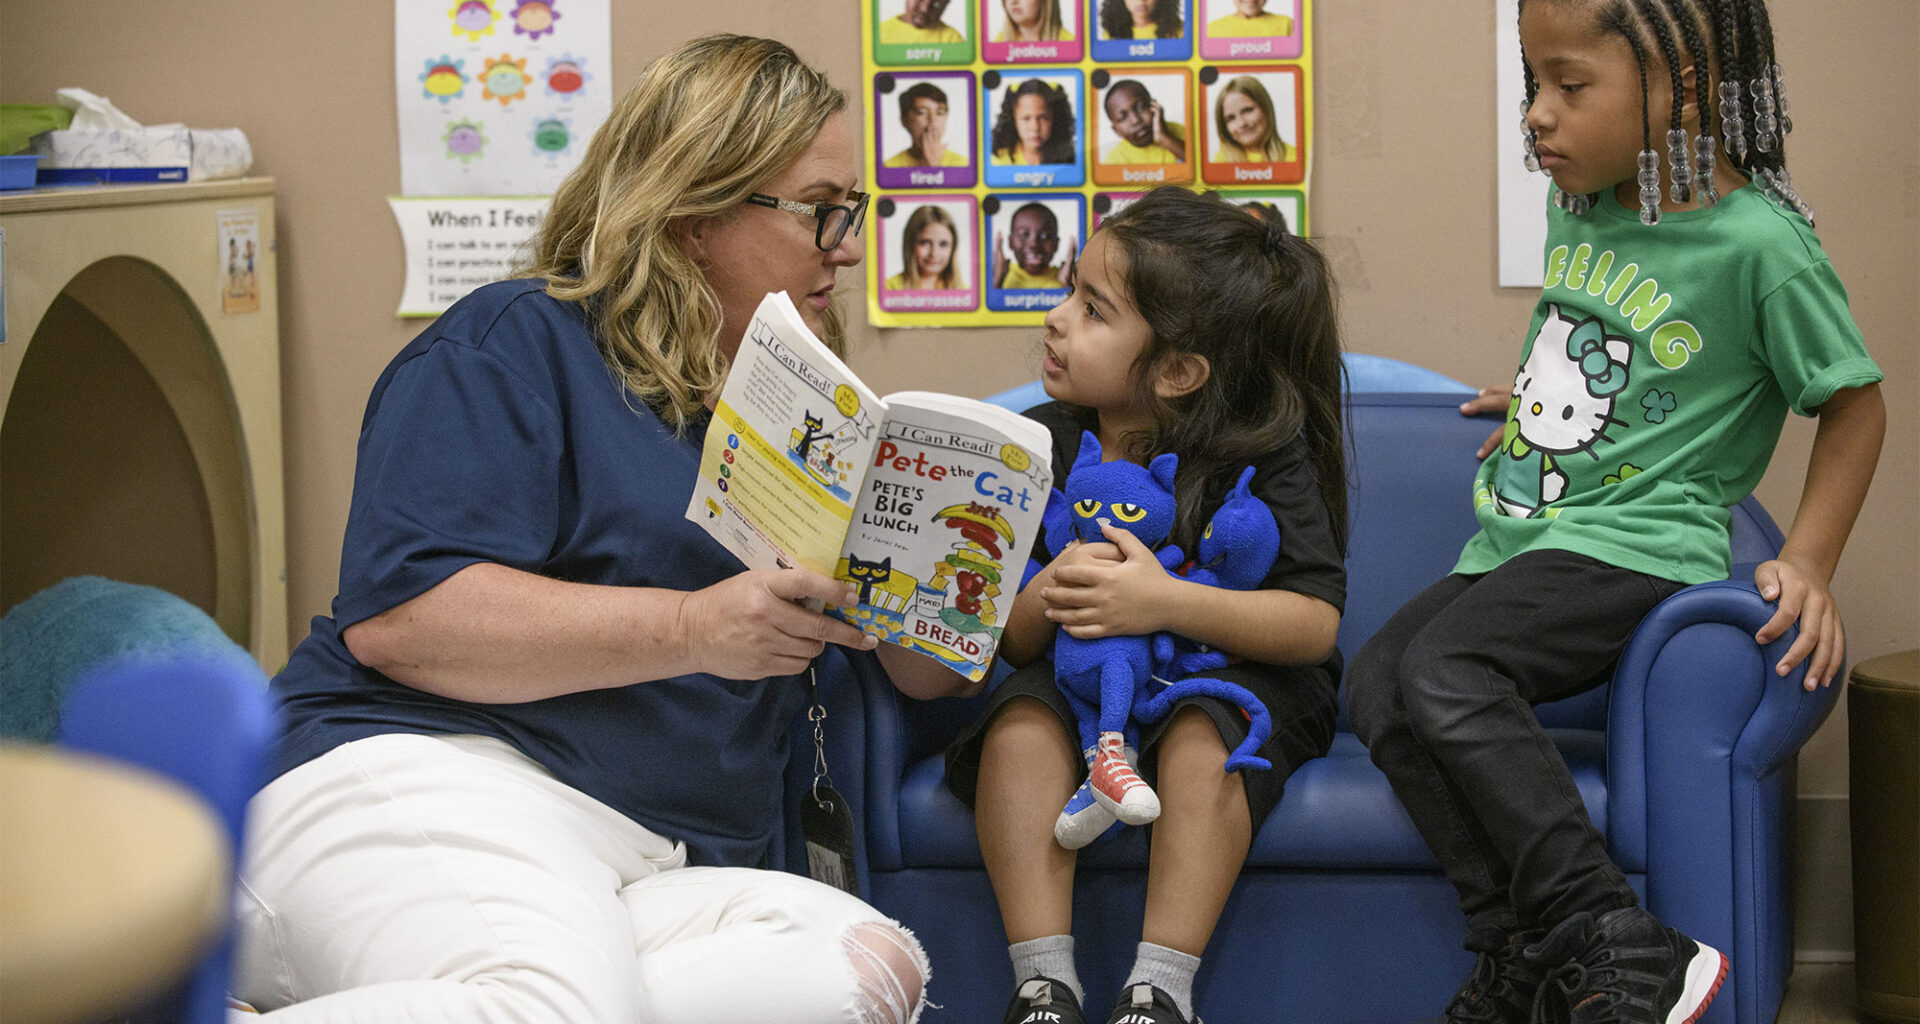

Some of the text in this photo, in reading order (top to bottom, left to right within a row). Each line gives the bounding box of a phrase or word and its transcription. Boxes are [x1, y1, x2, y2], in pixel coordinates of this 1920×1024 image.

[906, 47, 943, 62] sorry
[1006, 44, 1059, 62] jealous
[1129, 42, 1155, 56] sad
[1230, 40, 1272, 56] proud
[910, 171, 944, 185] tired
[1013, 171, 1056, 186] angry
[1122, 167, 1165, 182] bored
[1234, 166, 1273, 181] loved
[428, 208, 482, 227] When
[489, 209, 498, 227] I
[884, 294, 972, 308] embarrassed
[767, 336, 832, 395] I Can Read!
[730, 436, 737, 447] 1
[901, 427, 994, 455] I Can Read!
[725, 451, 733, 462] 2
[722, 466, 729, 477] 3
[874, 441, 1032, 512] Pete the Cat
[719, 481, 727, 491] 4
[872, 480, 925, 501] PETE'S
[875, 495, 914, 516] BIG
[862, 513, 919, 535] LUNCH
[919, 597, 941, 608] MAYO
[914, 619, 980, 656] BREAD
[1019, 1011, 1061, 1024] AIR
